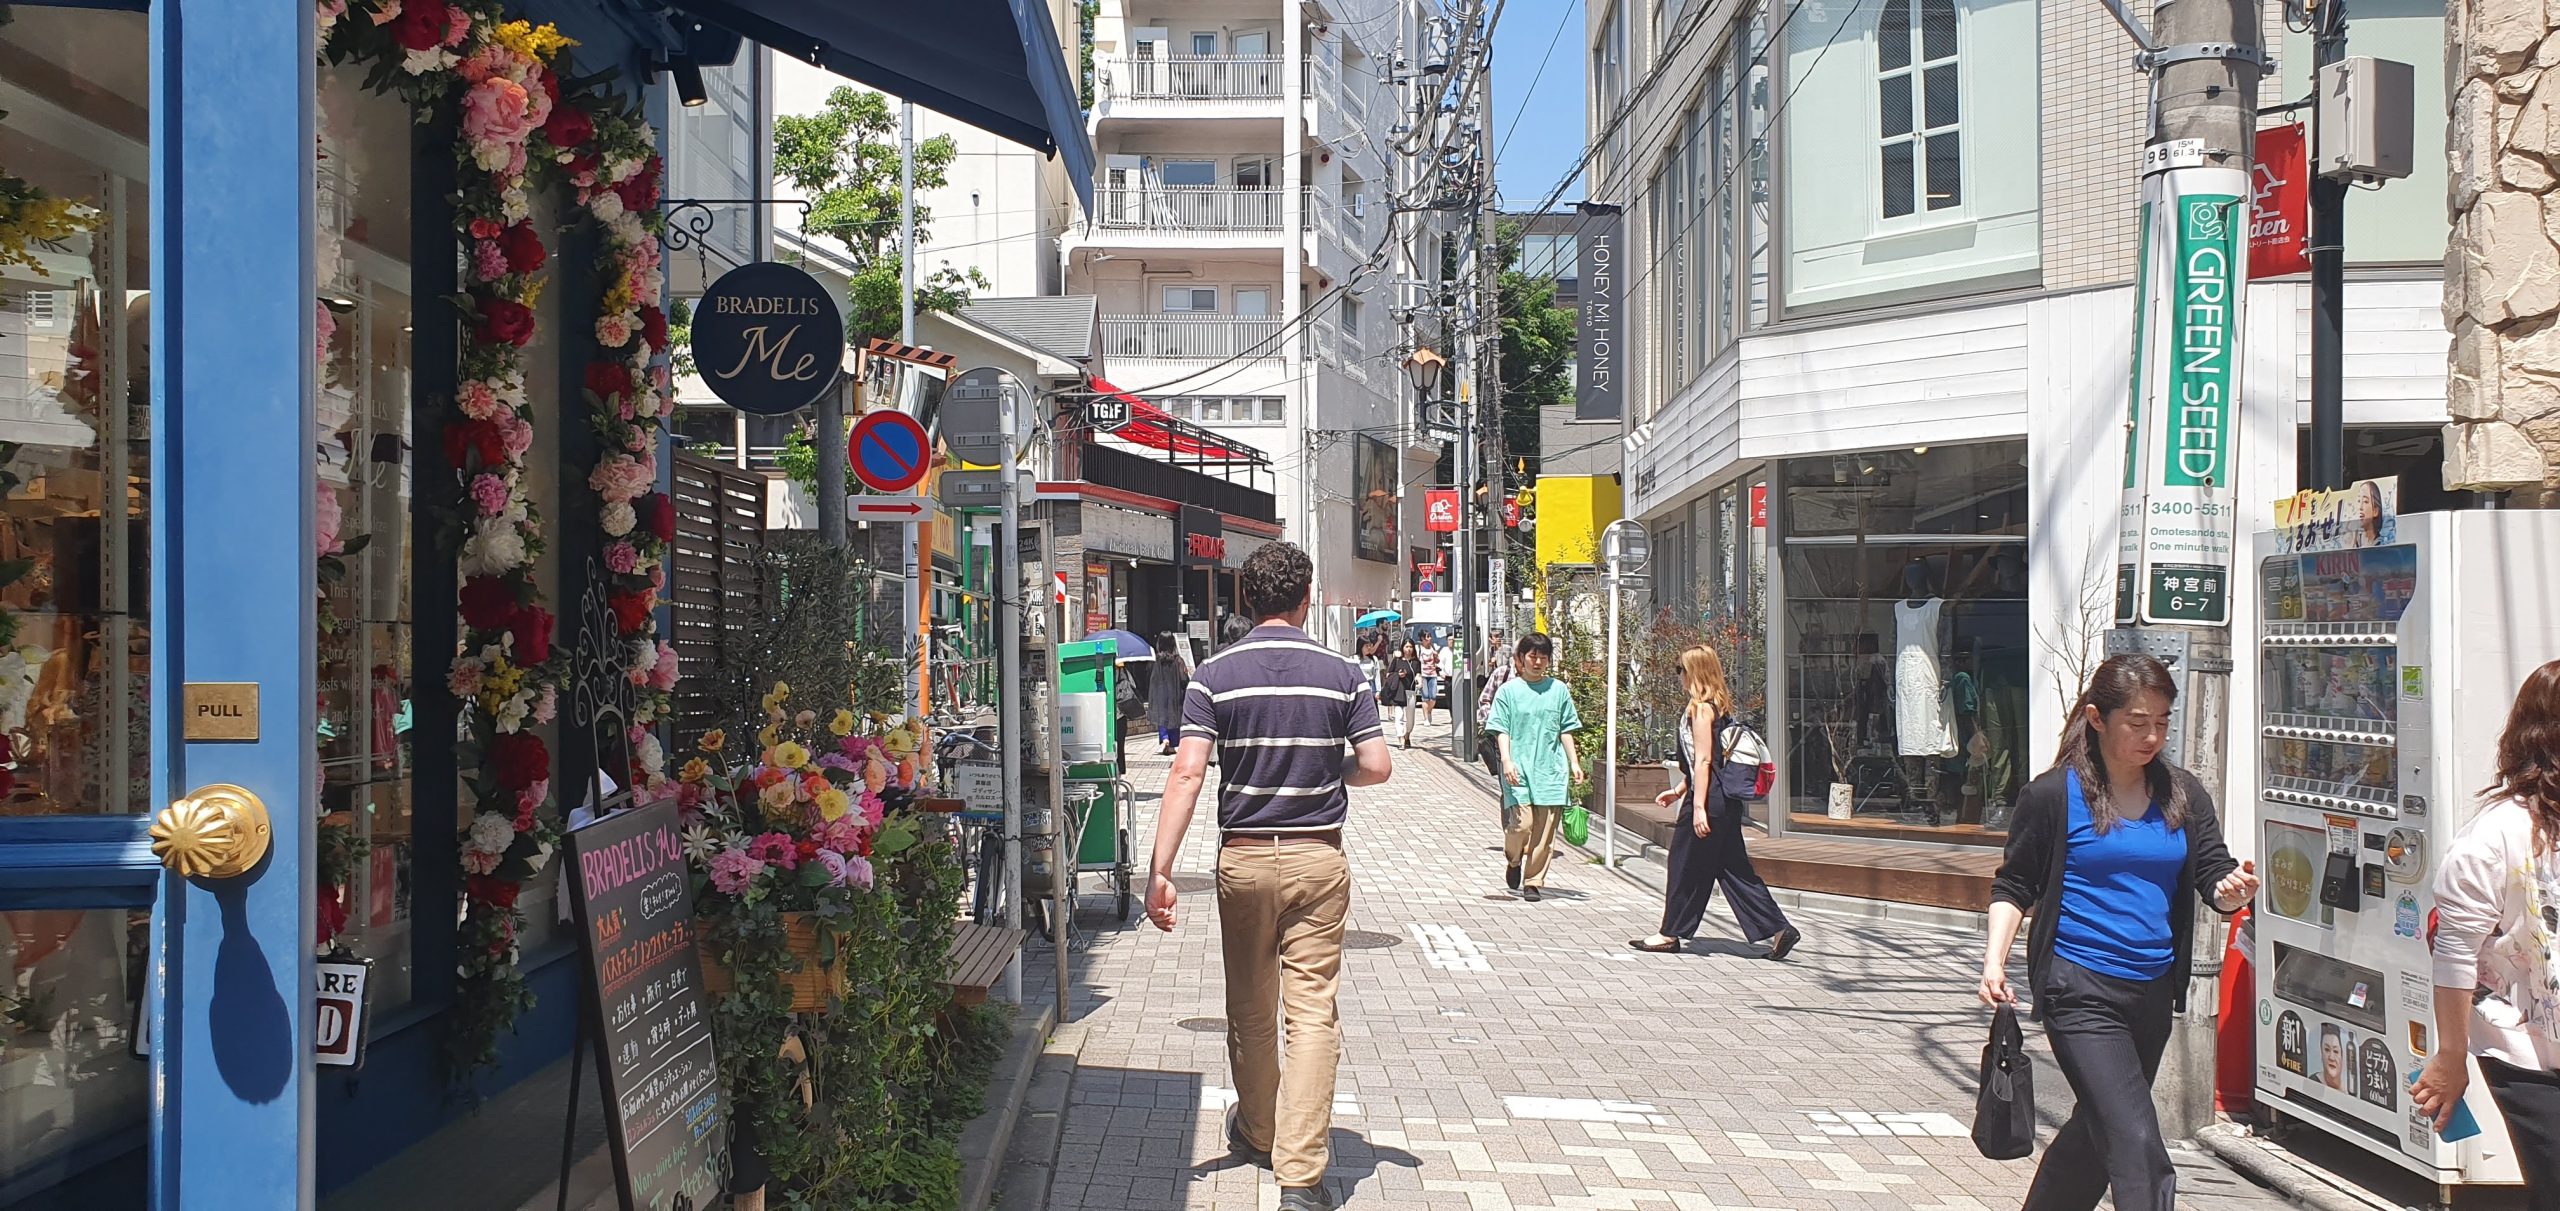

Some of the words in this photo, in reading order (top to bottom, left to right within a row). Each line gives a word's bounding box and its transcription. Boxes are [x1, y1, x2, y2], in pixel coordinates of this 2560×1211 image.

[1593, 235, 1610, 299] HONEY
[716, 296, 819, 316] BRADELIS
[2184, 247, 2227, 374] GREEN
[714, 324, 819, 381] Me
[1592, 328, 1610, 392] HONEY
[2178, 381, 2219, 478] SEED
[2151, 502, 2231, 517] 3400-5511
[2286, 492, 2317, 524] ノドを
[2150, 527, 2215, 538] Omotesando
[2216, 528, 2230, 539] sta.
[2150, 541, 2171, 552] One
[2174, 541, 2210, 553] minute
[2212, 544, 2230, 554] walk
[2316, 551, 2360, 577] KIRIN
[2163, 576, 2217, 593] 神宮前
[2171, 595, 2209, 612] 6-7
[198, 704, 243, 718] PULL
[582, 831, 655, 901] BRADELIS
[2286, 1060, 2302, 1073] FIRE
[633, 1155, 673, 1200] Non-wire
